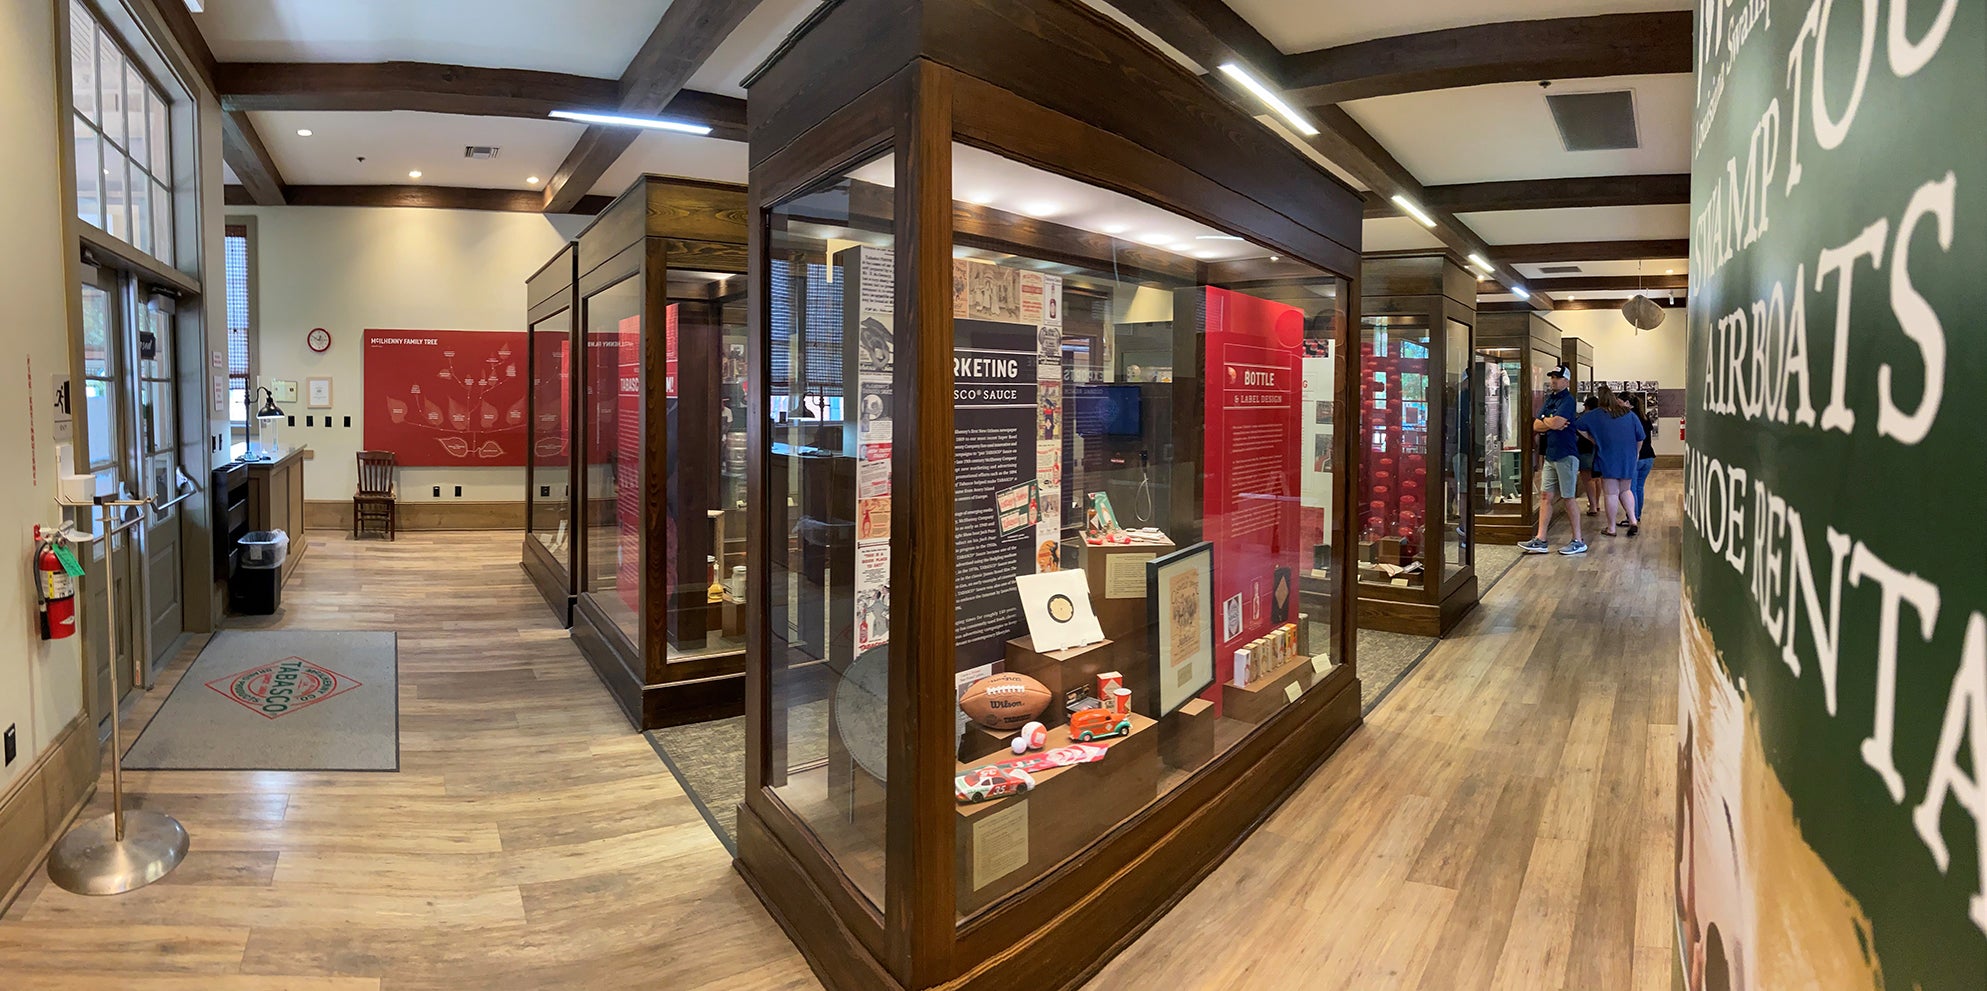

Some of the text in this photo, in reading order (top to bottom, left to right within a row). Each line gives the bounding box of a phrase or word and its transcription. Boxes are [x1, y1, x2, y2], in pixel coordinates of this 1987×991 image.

[1693, 98, 1780, 297] SWAMP
[1703, 169, 1957, 446] AIRBOATS
[954, 358, 1018, 378] RKETING
[1244, 371, 1275, 386] BOTTLE
[983, 390, 1017, 400] SAUCE
[1240, 395, 1260, 403] LABEL
[1260, 395, 1282, 403] DESIGN
[1684, 442, 1747, 575] CANOE
[262, 661, 302, 713] TABASCO
[990, 700, 1022, 709] Wilson
